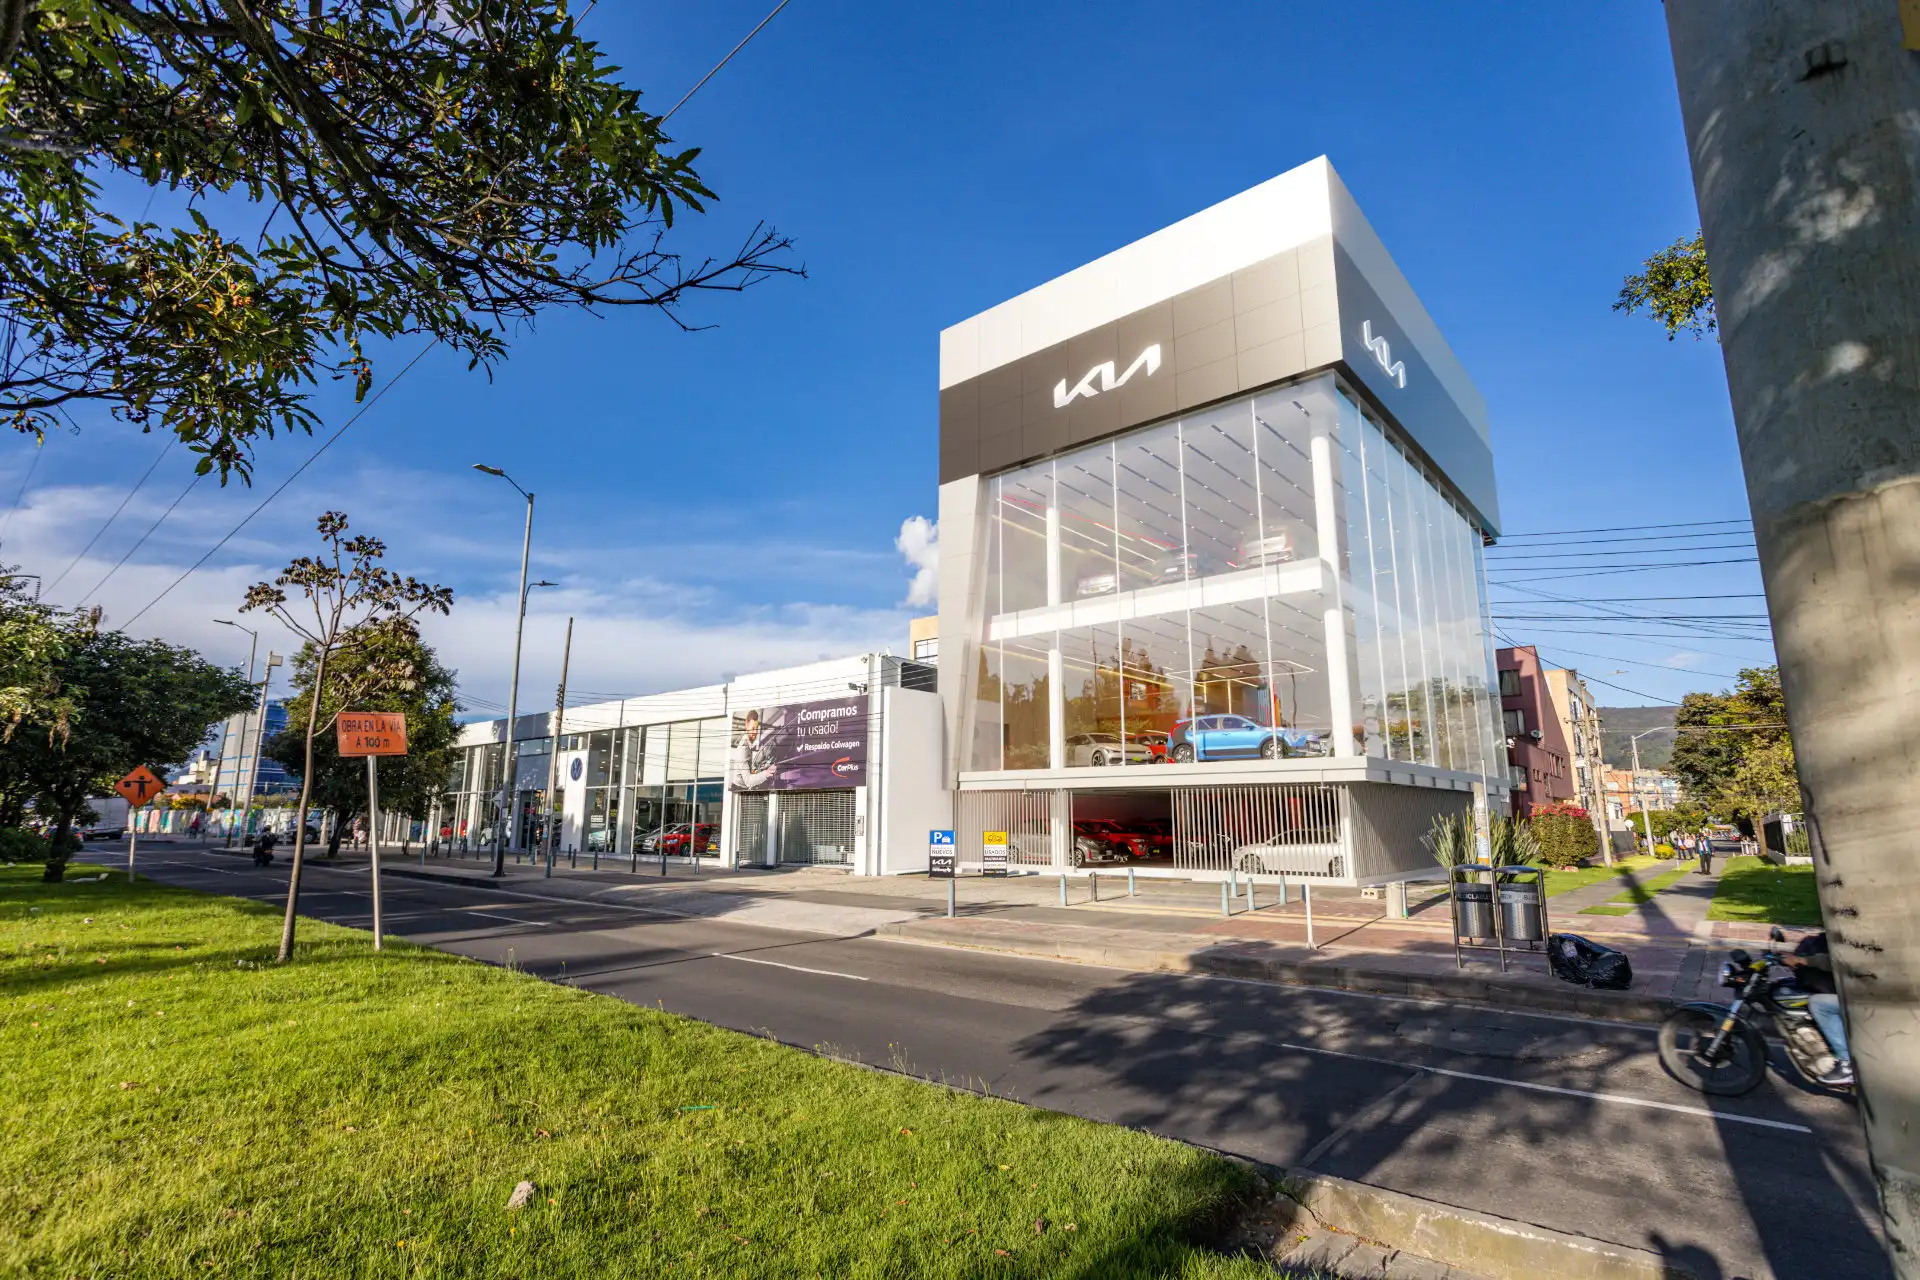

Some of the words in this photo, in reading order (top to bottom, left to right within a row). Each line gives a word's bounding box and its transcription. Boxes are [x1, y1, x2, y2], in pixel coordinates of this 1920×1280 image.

[1054, 344, 1161, 409] KIA
[797, 705, 858, 725] ¡Compramos
[342, 719, 362, 733] OBRA
[364, 719, 374, 733] EN
[376, 719, 386, 733] LA
[797, 726, 806, 737] tu
[808, 720, 839, 736] usado!
[356, 736, 362, 749] A
[364, 736, 380, 749] 100
[383, 738, 390, 749] m
[934, 831, 943, 844] P
